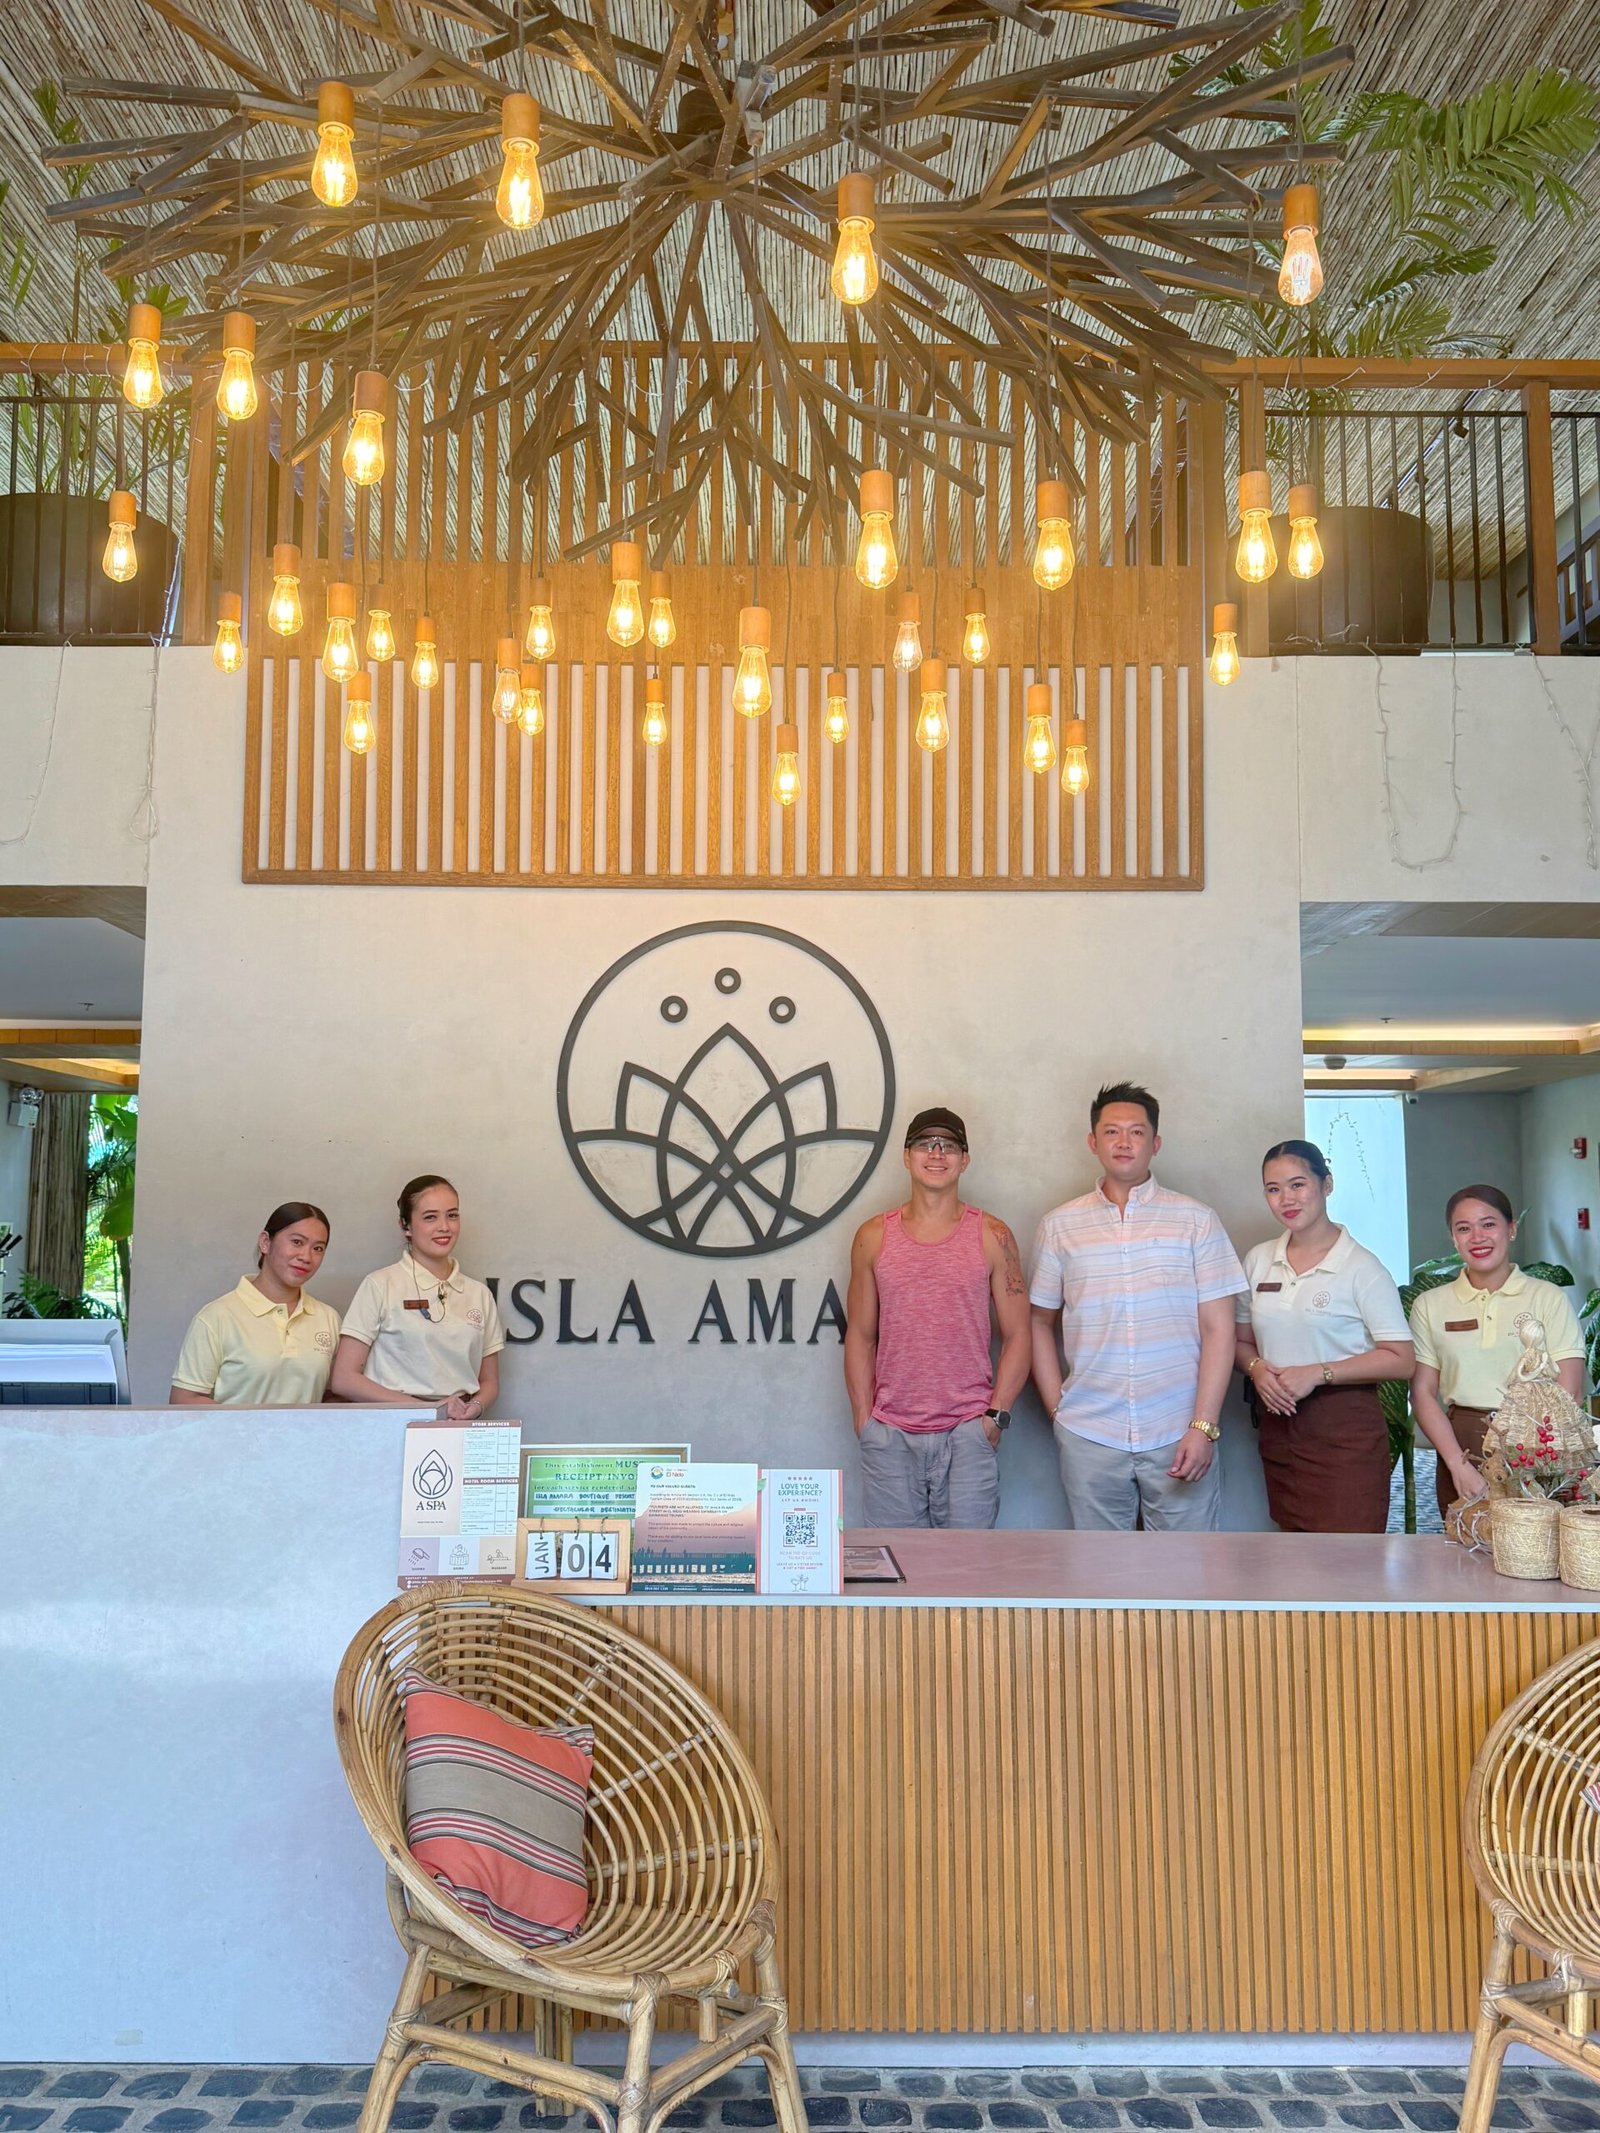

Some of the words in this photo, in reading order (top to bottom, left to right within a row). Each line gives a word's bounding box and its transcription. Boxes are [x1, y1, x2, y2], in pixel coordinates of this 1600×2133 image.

[416, 1501, 424, 1510] A
[426, 1500, 446, 1510] SPA
[534, 1541, 550, 1574] JAN
